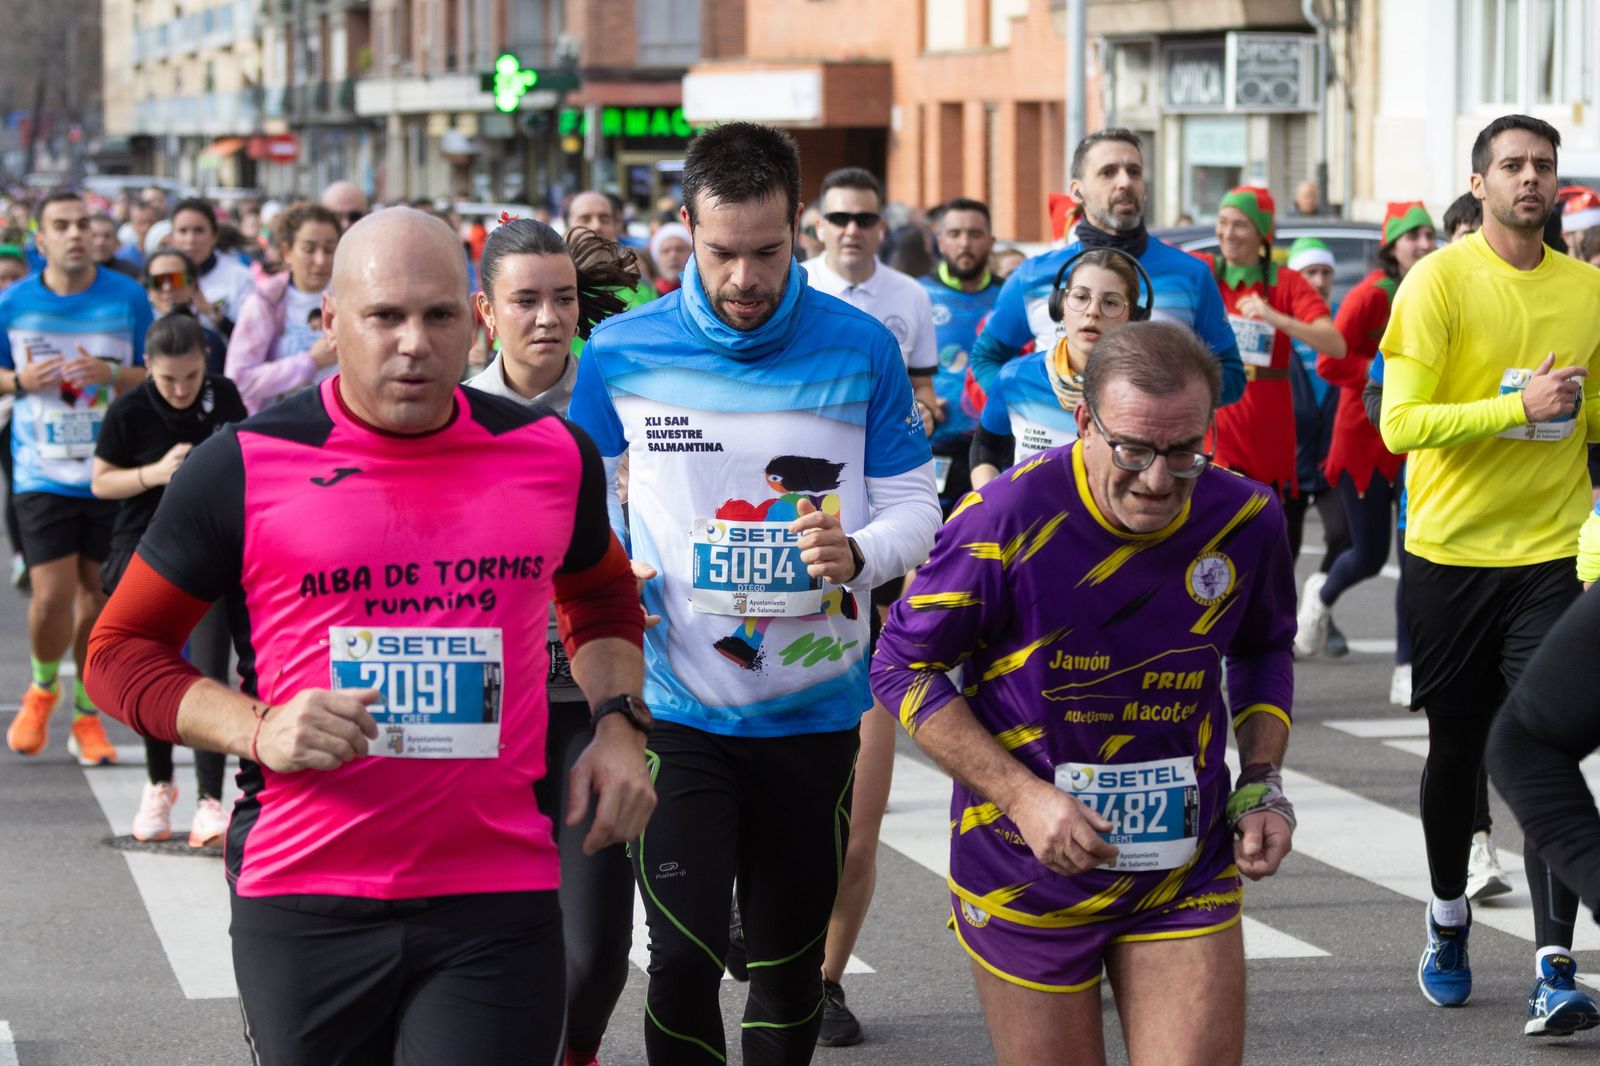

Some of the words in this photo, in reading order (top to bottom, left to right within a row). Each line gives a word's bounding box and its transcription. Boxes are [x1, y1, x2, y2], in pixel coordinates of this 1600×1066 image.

[645, 417, 661, 426] XLI
[664, 416, 689, 426] SAN
[646, 429, 703, 439] SILVESTRE
[648, 442, 724, 452] SALMANTINA
[729, 527, 804, 543] SETE
[709, 546, 795, 584] 5094
[301, 565, 371, 597] ALBA
[384, 562, 420, 588] DE
[433, 555, 544, 586] TORMES
[737, 584, 766, 592] DIEGO
[365, 588, 497, 616] running
[749, 599, 786, 608] Ayuntamiento
[377, 636, 487, 656] SETEL
[1049, 650, 1111, 671] Jamón
[1141, 670, 1206, 690] PRIM
[360, 662, 457, 714] 2091
[406, 735, 453, 745] Ayuntamiento
[417, 746, 453, 754] Salamanca
[1097, 766, 1185, 788] SETEL
[1109, 834, 1134, 844] REMI
[1119, 851, 1159, 861] Ayuntamiento
[1128, 860, 1159, 868] Salamanca
